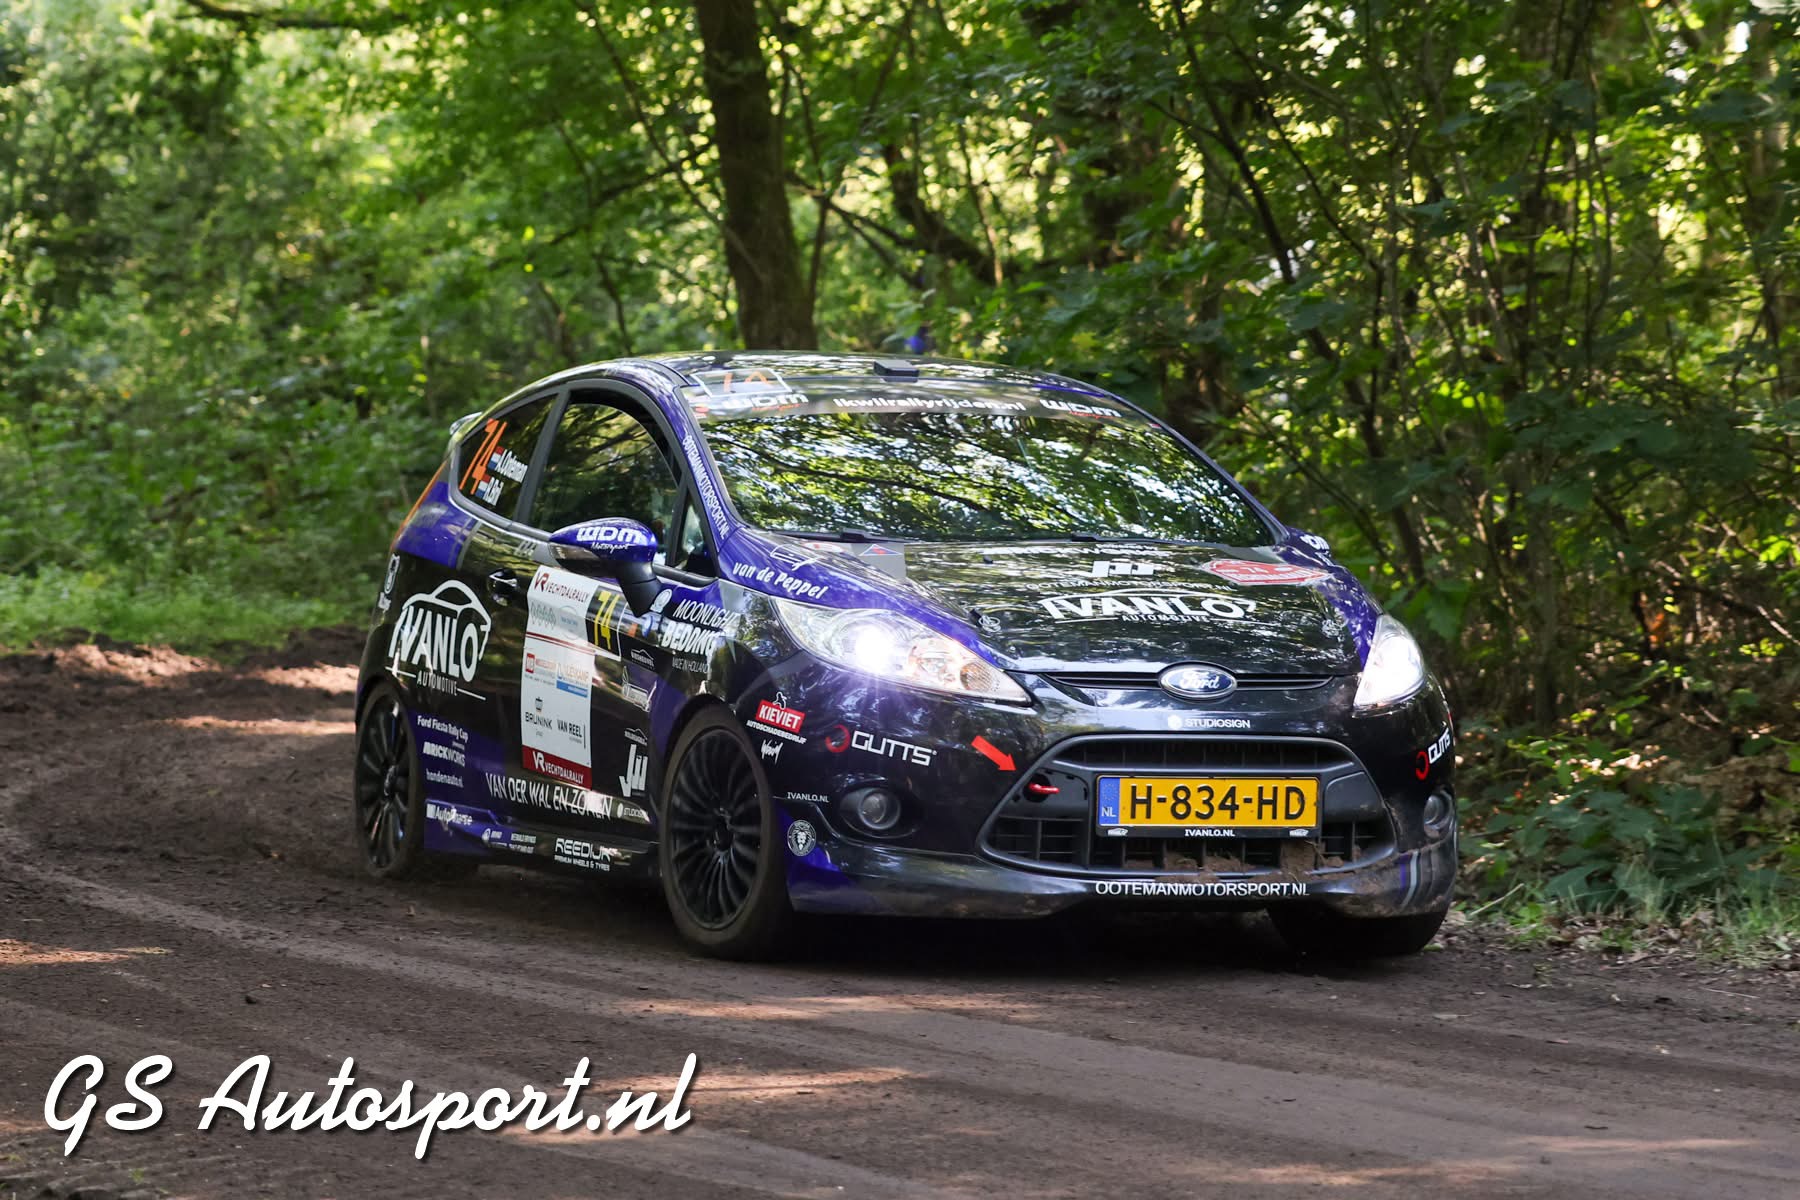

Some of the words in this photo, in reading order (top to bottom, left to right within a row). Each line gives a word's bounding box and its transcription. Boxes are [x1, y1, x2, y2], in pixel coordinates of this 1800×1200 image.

[459, 418, 508, 495] 74
[732, 562, 756, 578] van
[756, 562, 774, 582] de
[774, 573, 829, 599] Peppel
[594, 590, 621, 650] 74
[672, 599, 739, 629] MOONLIGHT
[1039, 595, 1248, 620] IVANLO
[388, 605, 479, 683] IVANLO
[661, 621, 721, 657] BEDDING
[416, 670, 458, 696] AUTOMOTIVE
[1179, 671, 1220, 689] Ford
[417, 715, 432, 729] Ford
[556, 719, 568, 733] VAN
[568, 722, 583, 738] REEL
[759, 704, 801, 729] KIEVIET
[1185, 718, 1251, 729] STUDIOSIGN
[545, 760, 584, 785] VECHTDALRALLY
[486, 772, 508, 800] VAN
[507, 777, 527, 805] DER
[528, 781, 552, 809] WAL
[553, 786, 569, 813] EN
[786, 791, 830, 803] IVANLO.NL
[1129, 784, 1306, 821] H-834-HD
[1101, 806, 1117, 818] NL
[1184, 828, 1236, 838] IVANLO.NL
